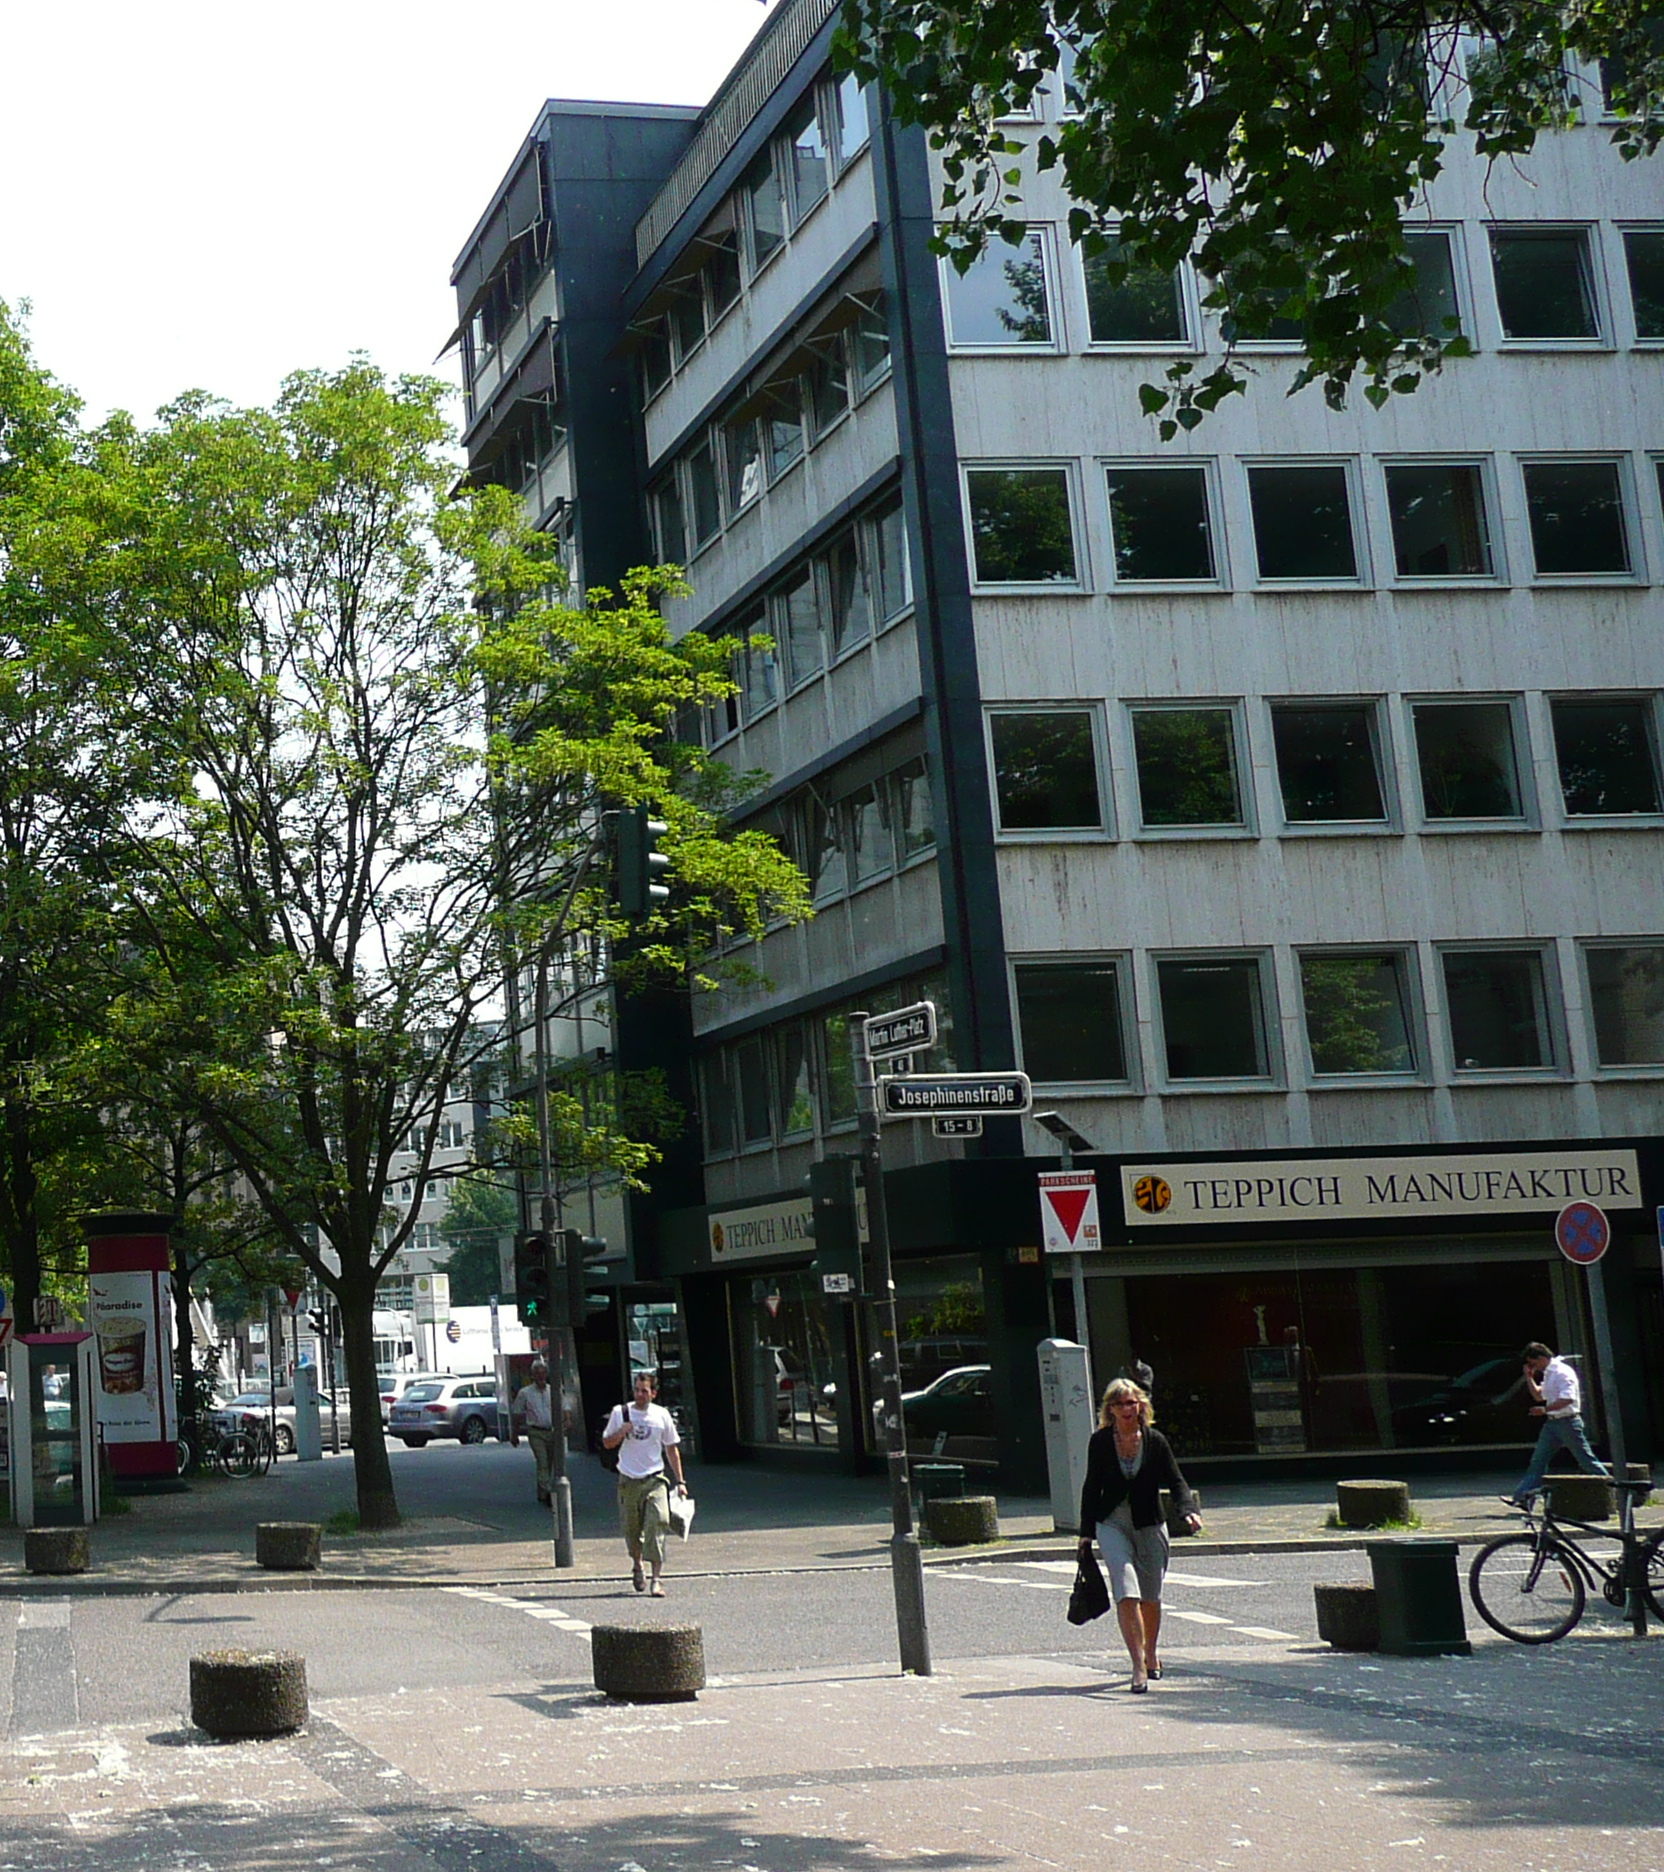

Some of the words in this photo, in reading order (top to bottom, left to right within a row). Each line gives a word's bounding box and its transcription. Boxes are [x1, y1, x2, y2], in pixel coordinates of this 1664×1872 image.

[898, 1084, 1015, 1108] Josephinenstraße
[1184, 1176, 1341, 1210] TEPPICH
[1365, 1166, 1634, 1205] MANUFAKTUR
[725, 1217, 776, 1249] TEPPICH
